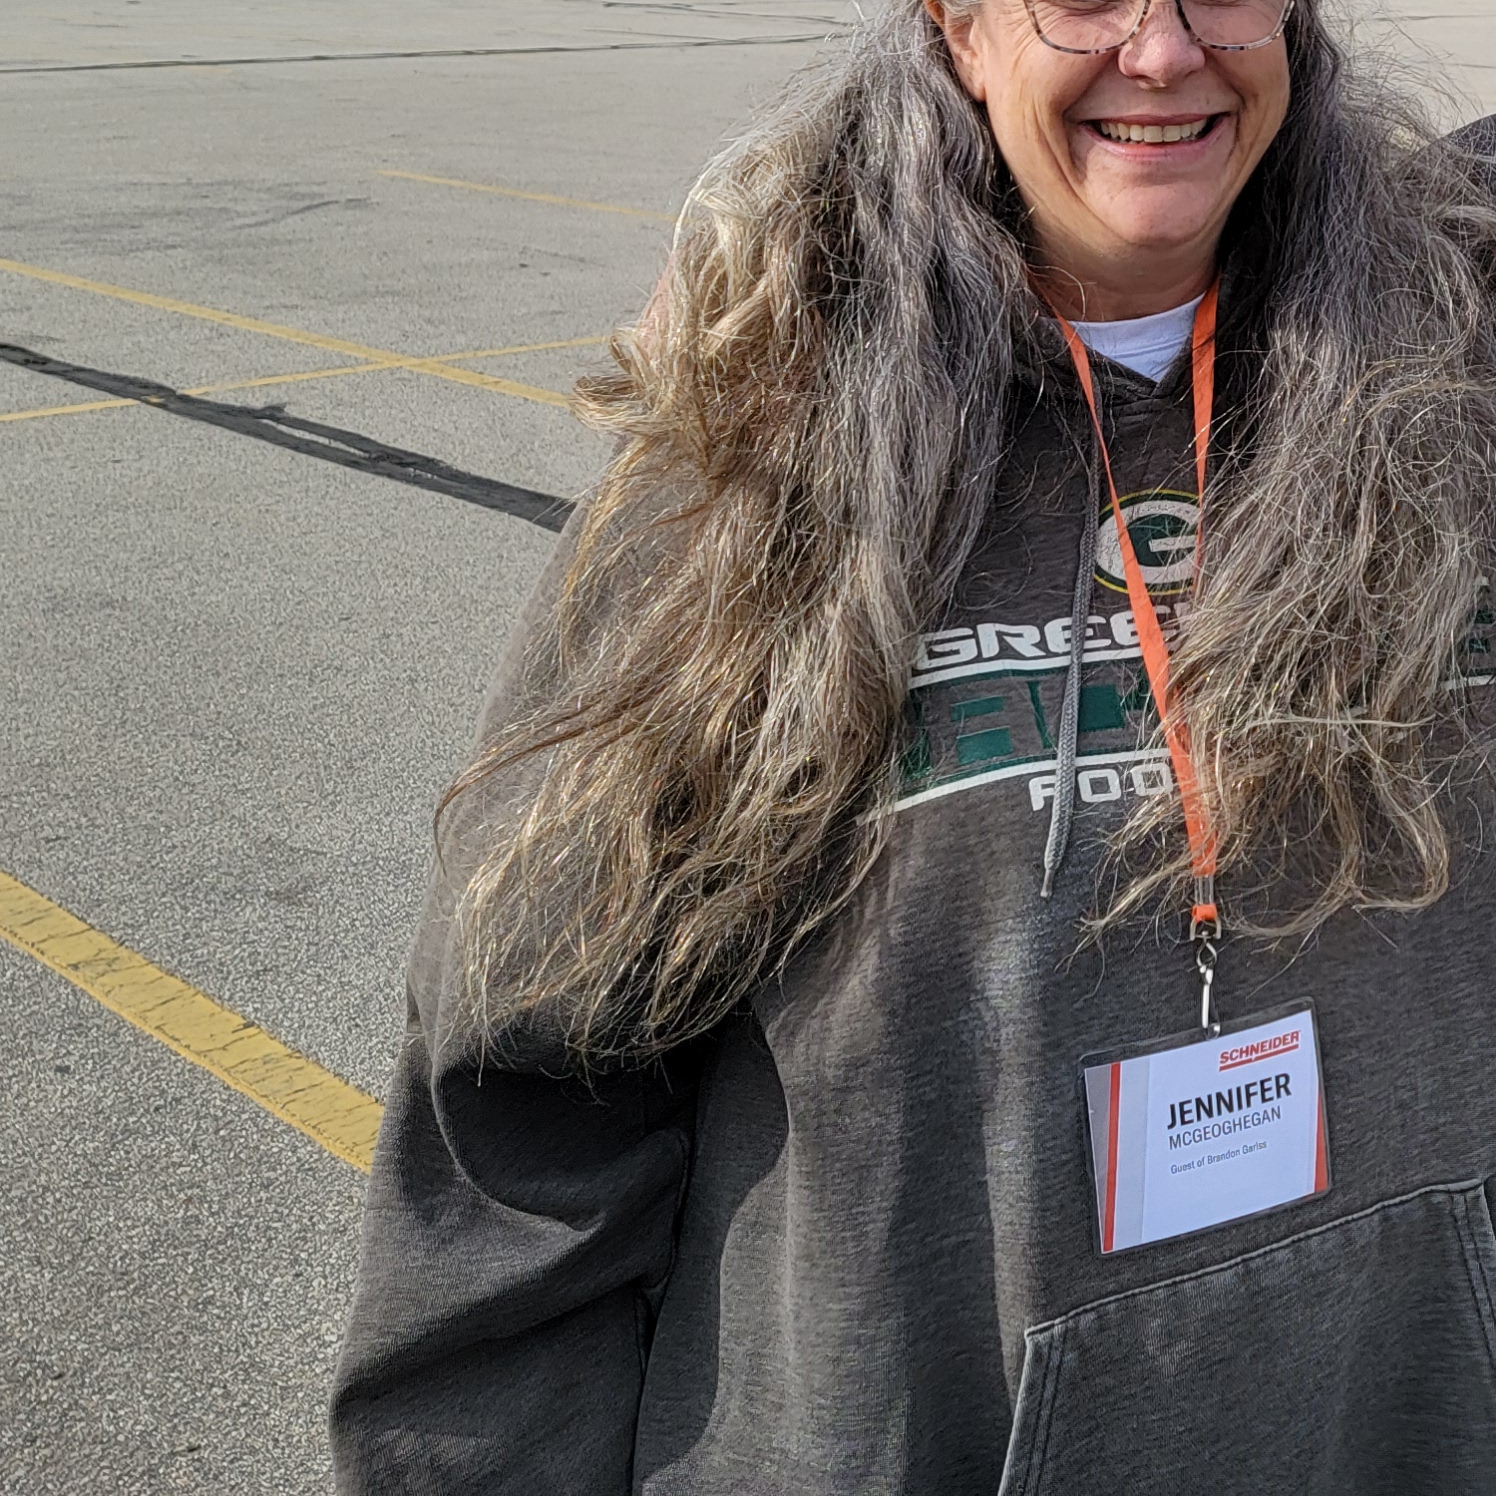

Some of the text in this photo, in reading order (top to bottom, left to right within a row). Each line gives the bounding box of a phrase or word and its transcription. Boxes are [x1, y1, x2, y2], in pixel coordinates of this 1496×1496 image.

[907, 602, 1190, 671] GREE
[1219, 1030, 1300, 1065] SCHNEIDER
[1167, 1072, 1292, 1130] JENNIFER
[1168, 1105, 1282, 1151] MCGEOGHEGAN
[1170, 1140, 1268, 1175] Guest of Brandon Gariss
